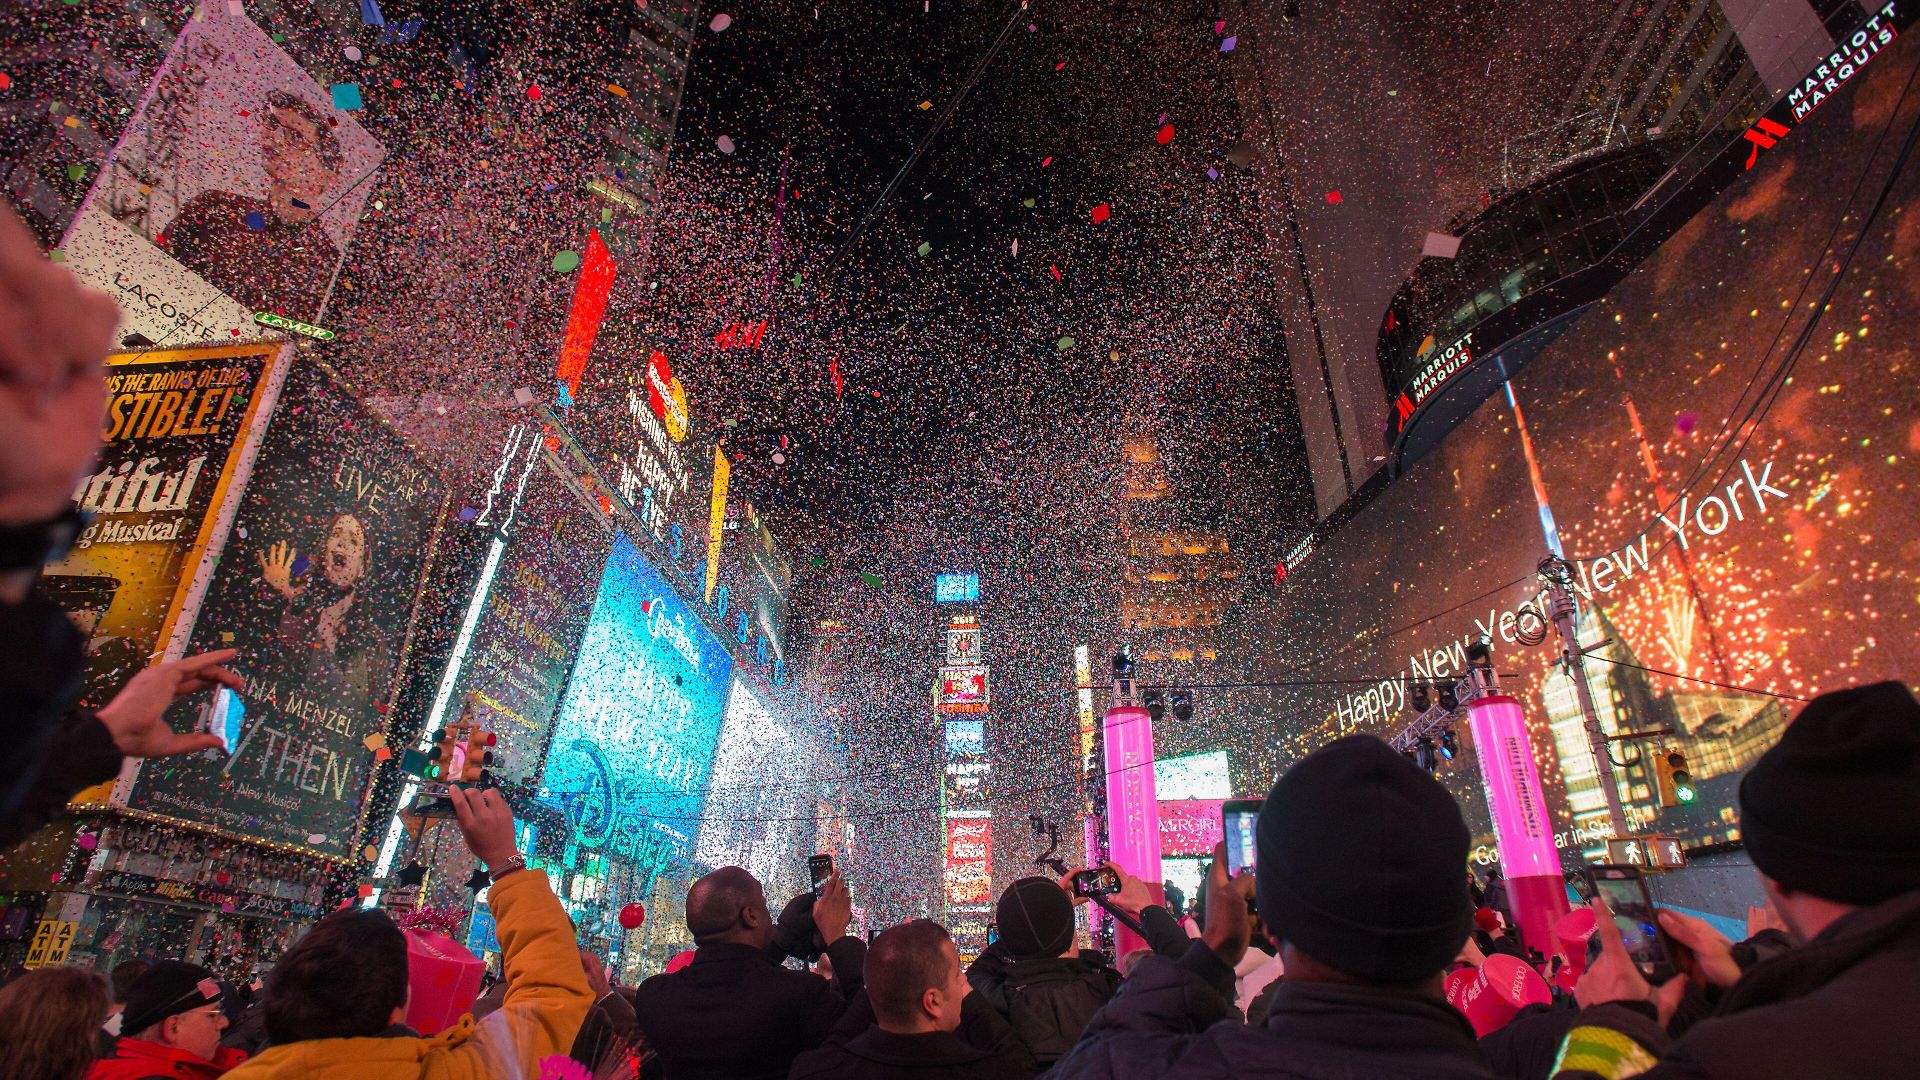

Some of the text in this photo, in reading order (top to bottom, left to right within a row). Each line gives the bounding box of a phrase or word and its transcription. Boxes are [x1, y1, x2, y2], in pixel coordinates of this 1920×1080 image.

[1788, 1, 1895, 105] MARRIOTT
[1795, 29, 1892, 118] MARQUIS
[113, 272, 215, 341] LACOSTE
[121, 374, 147, 392] THE
[148, 370, 196, 390] RANKS
[197, 369, 216, 387] OF
[215, 367, 245, 386] THE
[1413, 333, 1472, 390] MARRIOTT
[1416, 353, 1468, 402] MARQUIS
[336, 458, 385, 515] LIVE
[96, 517, 184, 543] Musical
[1287, 533, 1313, 562] MARRIOTT
[1288, 546, 1312, 571] MARQUIS
[1336, 671, 1405, 729] Happy
[1410, 634, 1470, 684] New
[1475, 590, 1549, 651] Year
[1656, 459, 1788, 550] York
[284, 692, 355, 738] MENZEL
[940, 702, 989, 713] TOSHIBA
[236, 782, 264, 800] New
[266, 789, 301, 811] Musical
[564, 739, 671, 896] Disney
[1553, 831, 1568, 848] ar
[1570, 825, 1588, 844] in
[120, 878, 147, 892] Apple
[250, 896, 285, 912] SONY
[30, 924, 50, 961] ATM
[50, 925, 71, 962] ATM
